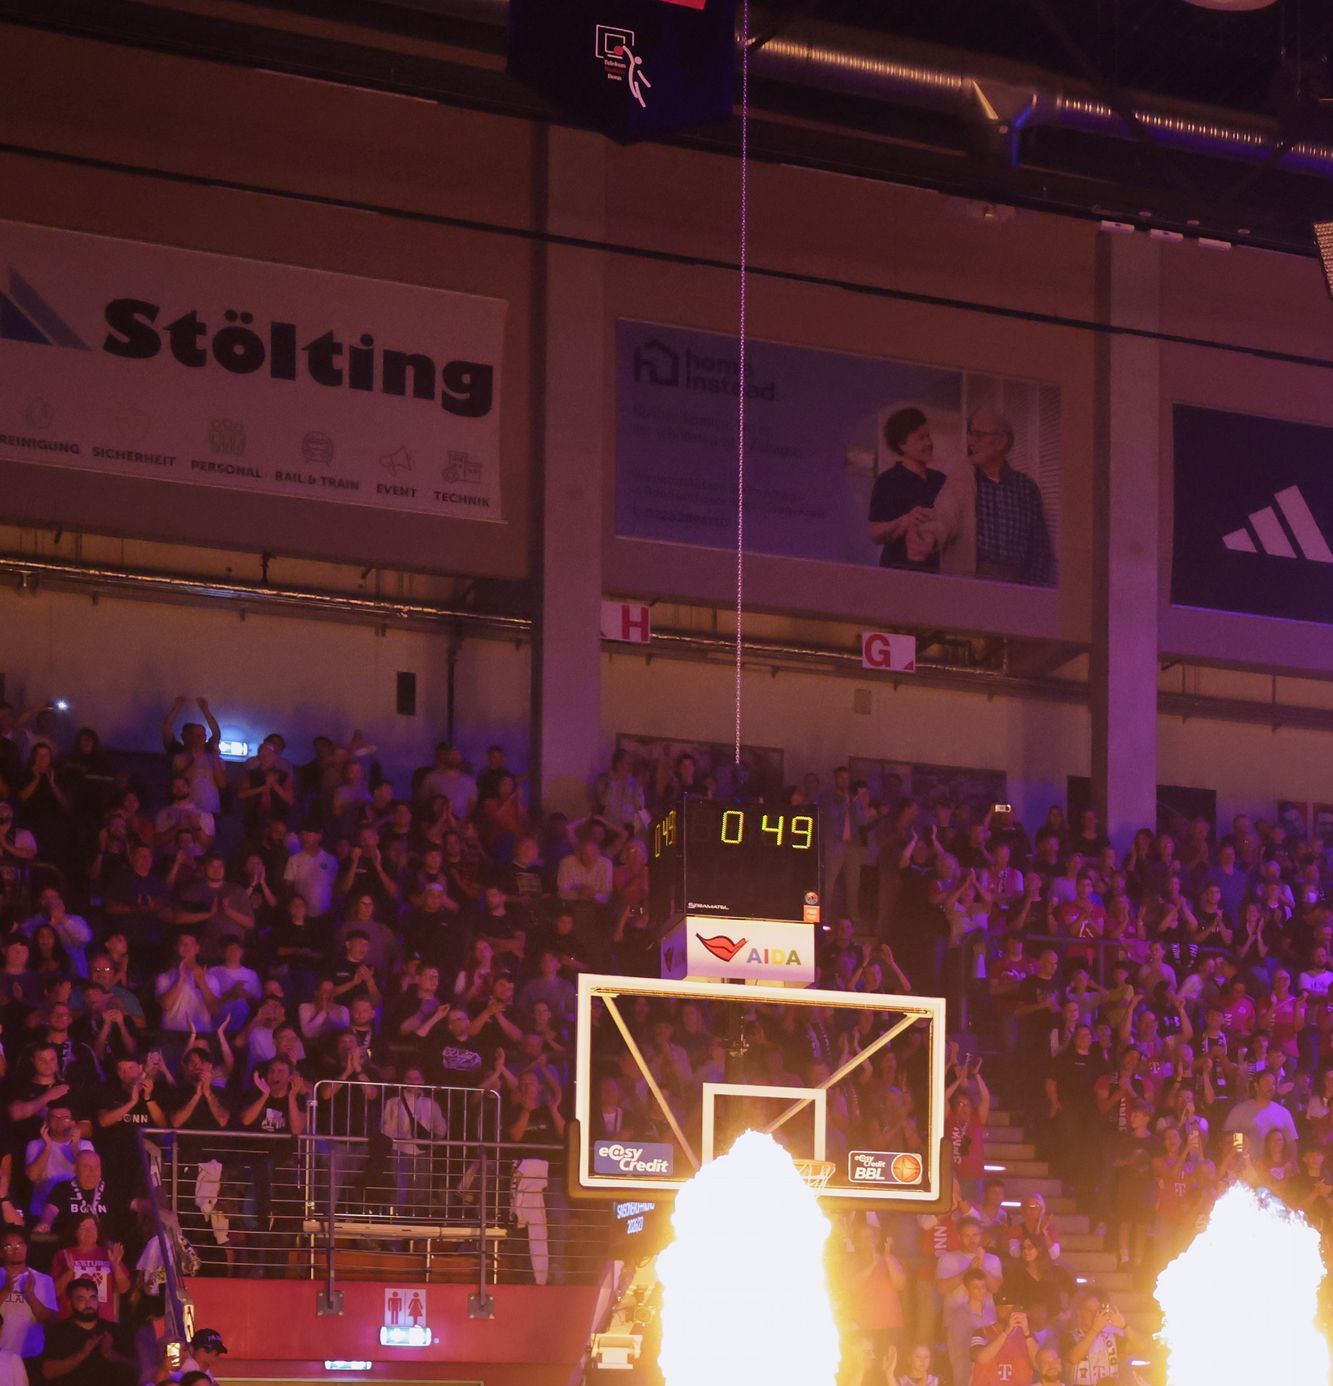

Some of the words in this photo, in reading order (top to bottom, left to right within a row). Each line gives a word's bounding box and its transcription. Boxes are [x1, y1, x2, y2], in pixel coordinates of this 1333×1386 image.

[102, 297, 494, 418] Stölting
[92, 446, 177, 468] SICHERHEIT
[191, 460, 263, 479] PERSONAL
[275, 470, 305, 485] RAIL
[320, 474, 360, 491] TRAIN
[376, 483, 418, 499] EVENT
[434, 490, 491, 508] TECHNIK
[621, 605, 649, 642] H
[864, 633, 891, 668] G
[721, 810, 744, 844] 0
[761, 814, 814, 850] 49
[746, 947, 802, 966] AIDA
[619, 1156, 669, 1174] Credit
[854, 1167, 886, 1181] BBL
